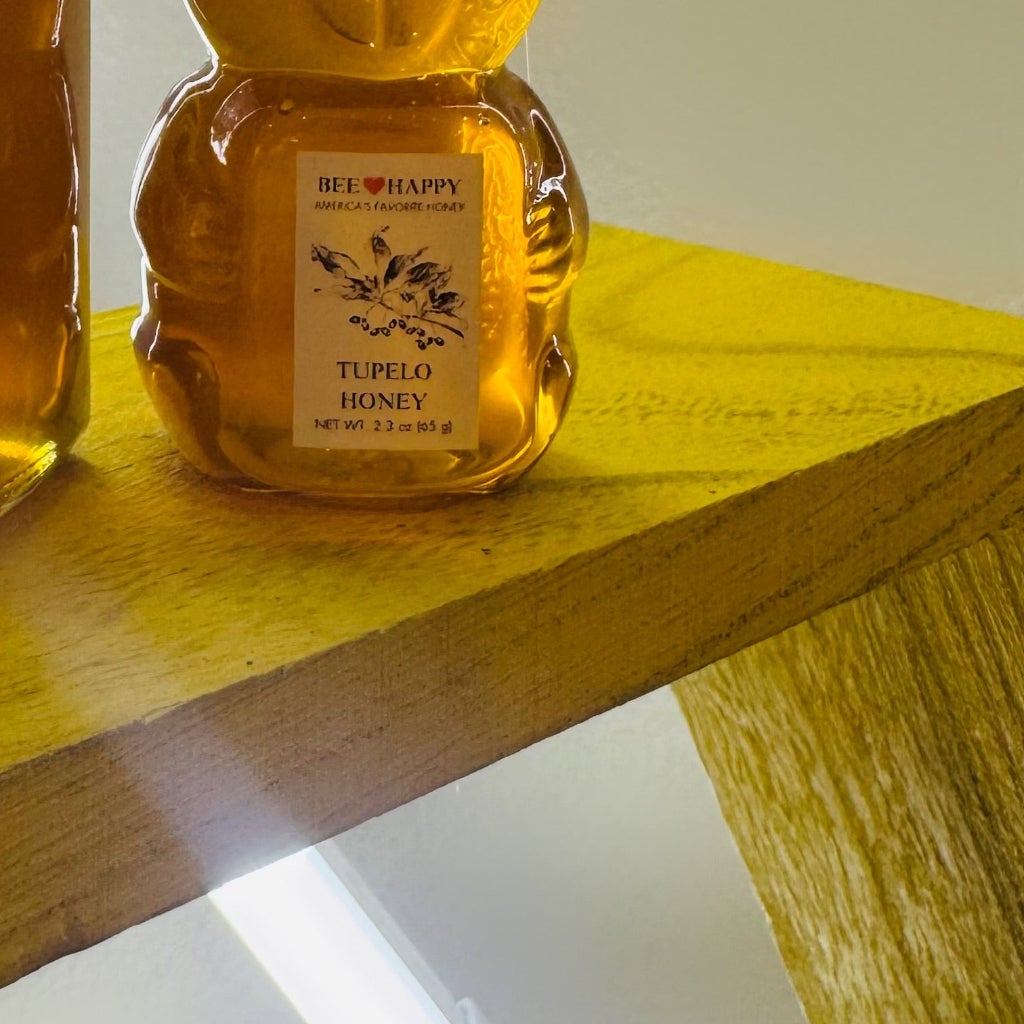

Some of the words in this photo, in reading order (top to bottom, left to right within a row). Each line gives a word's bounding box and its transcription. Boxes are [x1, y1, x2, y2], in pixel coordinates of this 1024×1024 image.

[319, 176, 360, 194] BEE
[388, 179, 462, 196] HAPPY
[336, 361, 432, 381] TUPELO
[341, 392, 428, 411] HONEY
[314, 419, 340, 430] NET
